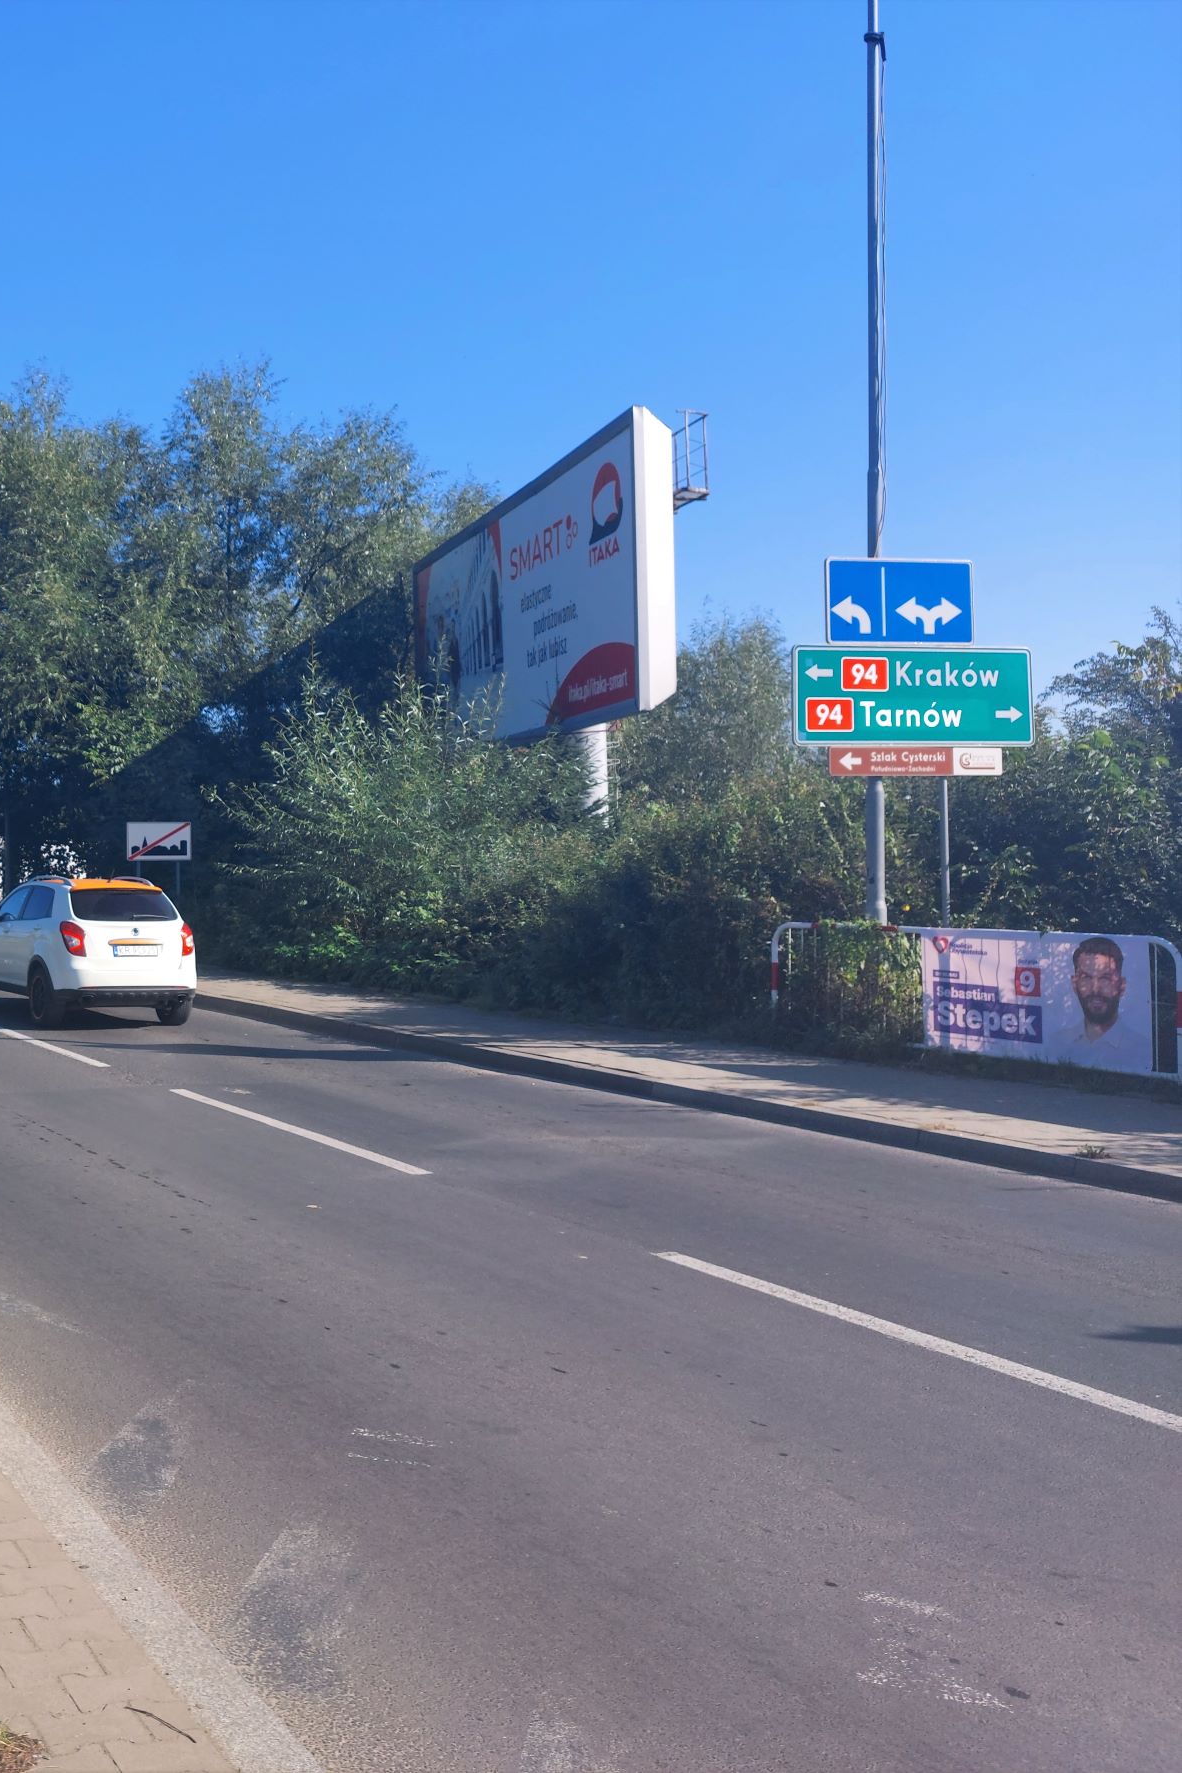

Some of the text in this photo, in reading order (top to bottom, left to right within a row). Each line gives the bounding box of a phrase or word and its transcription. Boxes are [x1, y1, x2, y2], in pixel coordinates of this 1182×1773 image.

[509, 519, 563, 581] SMART
[588, 535, 620, 569] ITAKA
[520, 584, 552, 613] elastyczne
[527, 645, 537, 669] tak
[538, 640, 548, 668] jak
[851, 660, 1000, 687] 94 Kraków
[816, 701, 962, 728] 94 Tarnów
[871, 751, 946, 764] Szlak Cysterski
[936, 985, 995, 1002] Sebastian
[1019, 971, 1036, 993] 9
[937, 1000, 1037, 1038] Stepek
